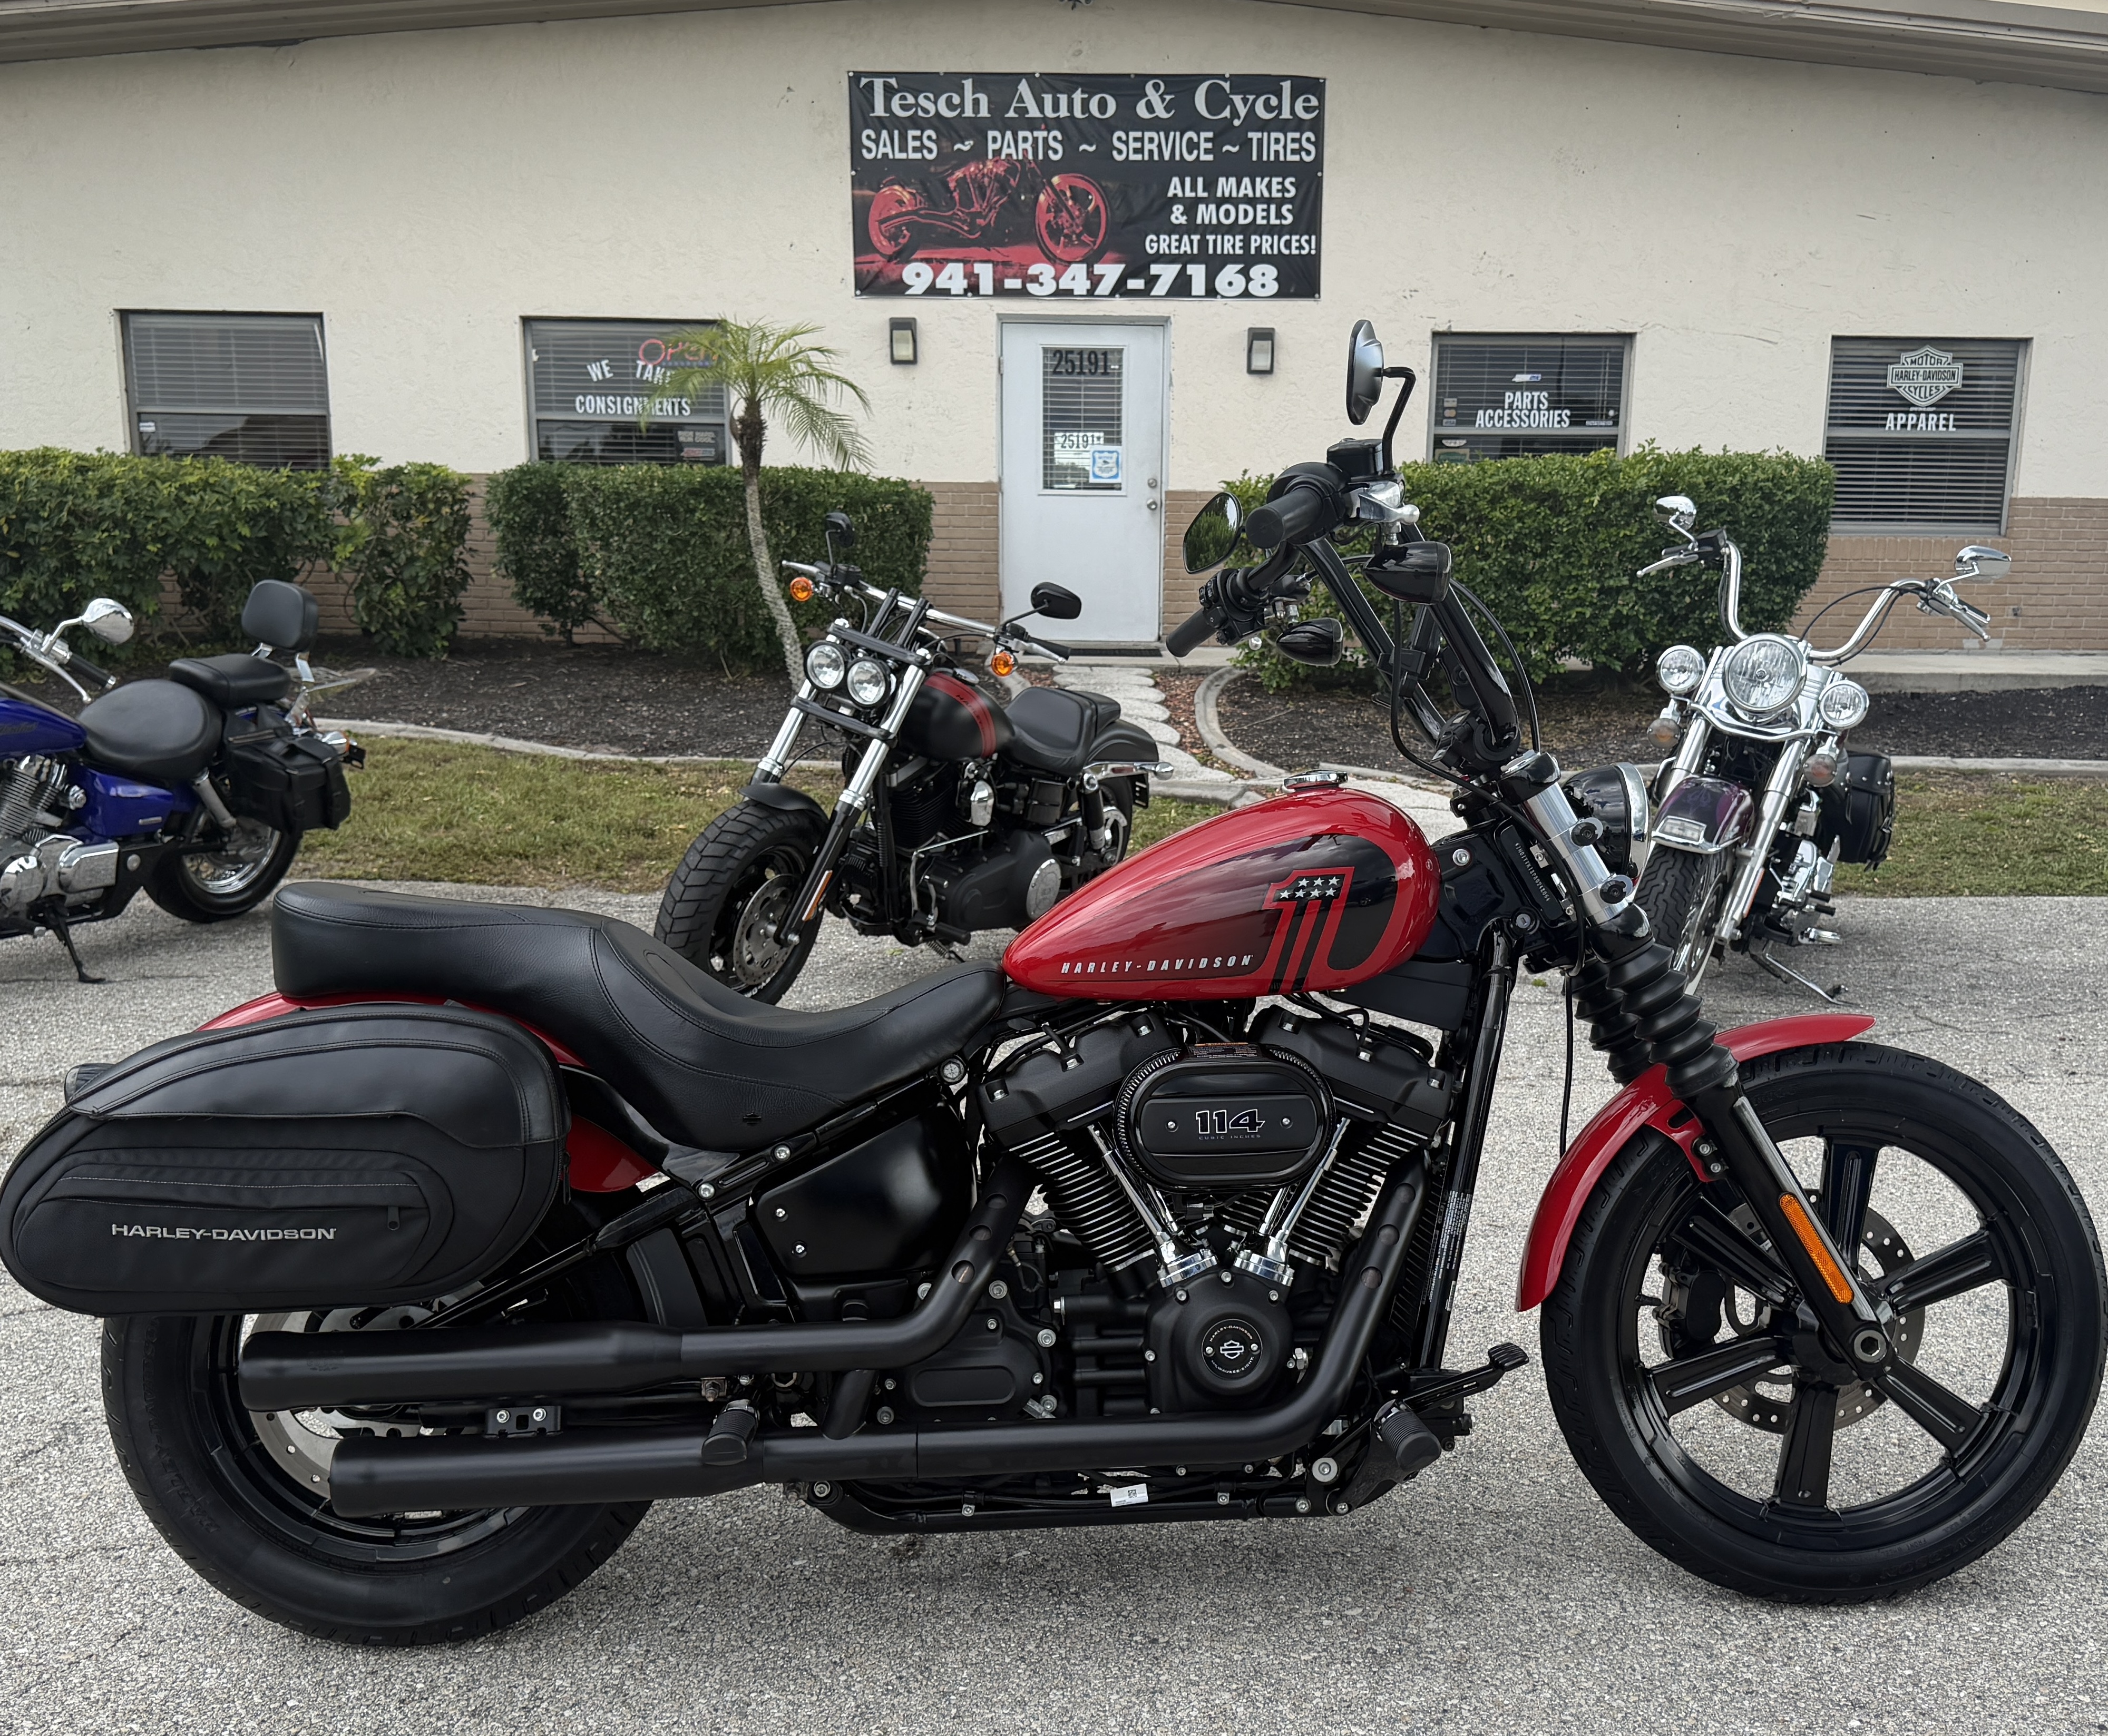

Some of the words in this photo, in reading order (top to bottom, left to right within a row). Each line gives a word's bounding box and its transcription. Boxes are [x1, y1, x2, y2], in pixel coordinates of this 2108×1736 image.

[860, 77, 991, 120] Tesch
[1006, 79, 1117, 120] Auto
[1135, 80, 1175, 120] &
[1194, 79, 1320, 126] Cycle
[861, 129, 938, 160] SALES
[987, 130, 1063, 161] PARTS
[1112, 131, 1214, 161] SERVICE
[1248, 132, 1316, 162] TIRES
[1167, 177, 1209, 198] ALL
[1216, 177, 1297, 199] MAKES
[1170, 204, 1189, 225] &
[1196, 204, 1294, 226] MODELS
[1145, 234, 1200, 256] GREAT
[1206, 234, 1245, 256] TIRE
[1250, 235, 1317, 256] PRICES!
[902, 262, 1280, 297] 941-347-7168
[587, 359, 614, 382] WE
[1052, 349, 1110, 376] 25191
[1910, 354, 1943, 366] MOTOR
[1895, 370, 1956, 381] HARLEY-DAVIDSON
[1505, 391, 1549, 409] PARTS
[1908, 386, 1941, 399] CYCLES
[575, 395, 691, 416] CONSIGNENTS
[1475, 409, 1571, 428] ACCESSORIES
[1885, 413, 1956, 431] APPAREL
[1060, 434, 1095, 449] 25191
[1061, 955, 1251, 974] HARLEY-DAVIDSON
[1195, 1109, 1265, 1134] 114
[112, 1223, 336, 1241] HARLEY-DAVIDSON
